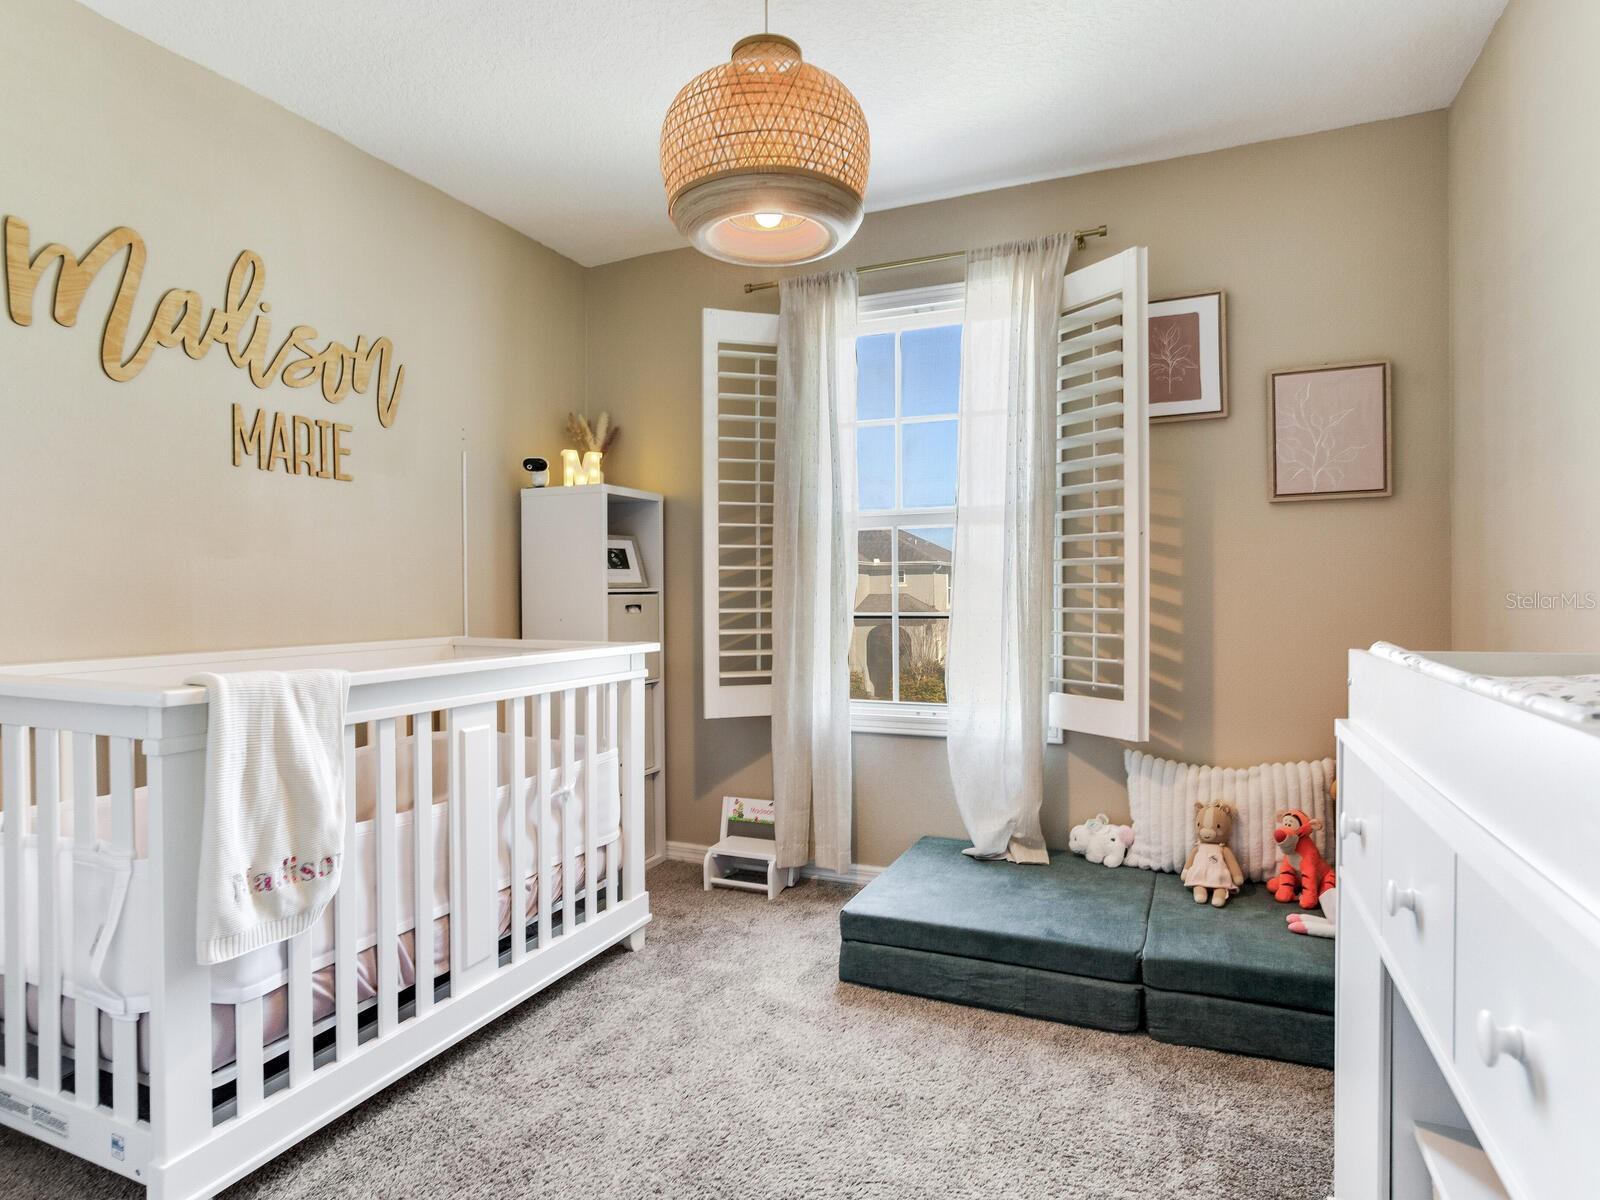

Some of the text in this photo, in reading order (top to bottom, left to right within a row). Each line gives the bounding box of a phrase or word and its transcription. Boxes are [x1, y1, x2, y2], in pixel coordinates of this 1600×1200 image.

[4, 215, 404, 428] Madison
[232, 402, 353, 482] MARIE
[561, 449, 603, 487] M
